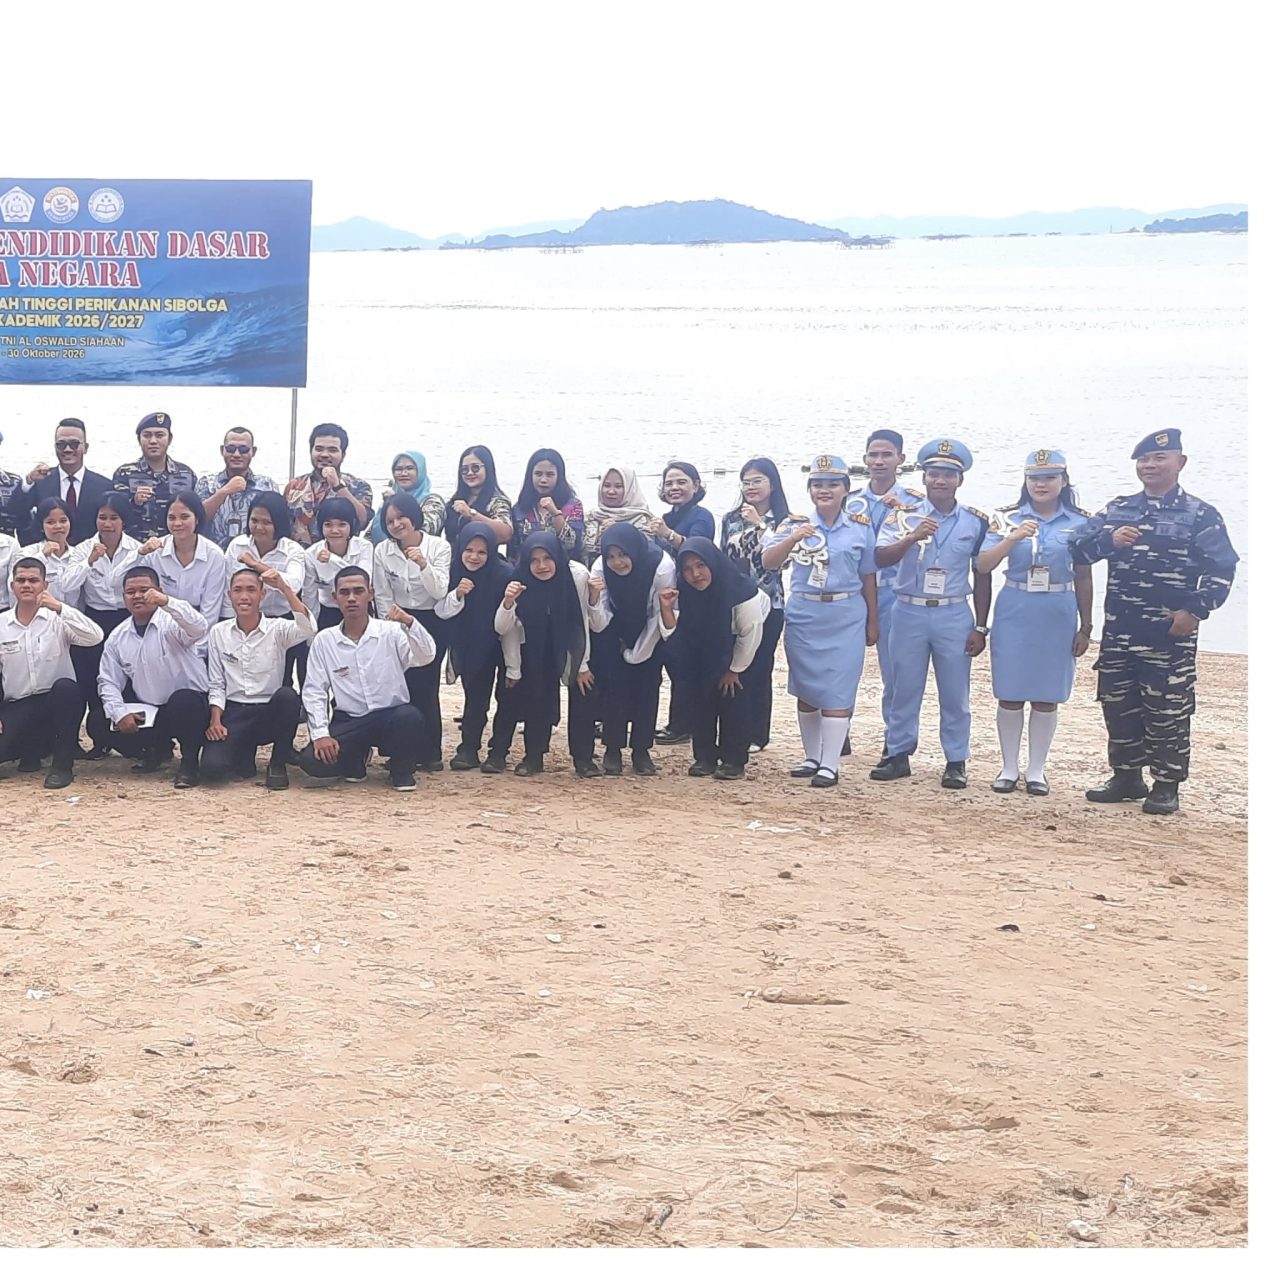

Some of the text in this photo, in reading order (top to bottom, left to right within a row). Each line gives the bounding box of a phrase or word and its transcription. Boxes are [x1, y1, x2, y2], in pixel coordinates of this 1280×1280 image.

[167, 230, 270, 260] DASAR
[18, 259, 141, 289] NEGARA
[22, 297, 73, 311] TINGGI
[75, 298, 161, 312] PERIKANAN
[164, 298, 228, 313] SIBOLGA
[65, 313, 145, 331] 2026/2027
[0, 336, 17, 346] TNI
[19, 336, 32, 346] AL
[35, 336, 77, 347] OSWALD
[80, 336, 125, 347] SIAHAAN
[8, 348, 20, 358] 30
[22, 348, 61, 358] Oktober
[63, 349, 85, 359] 2026
